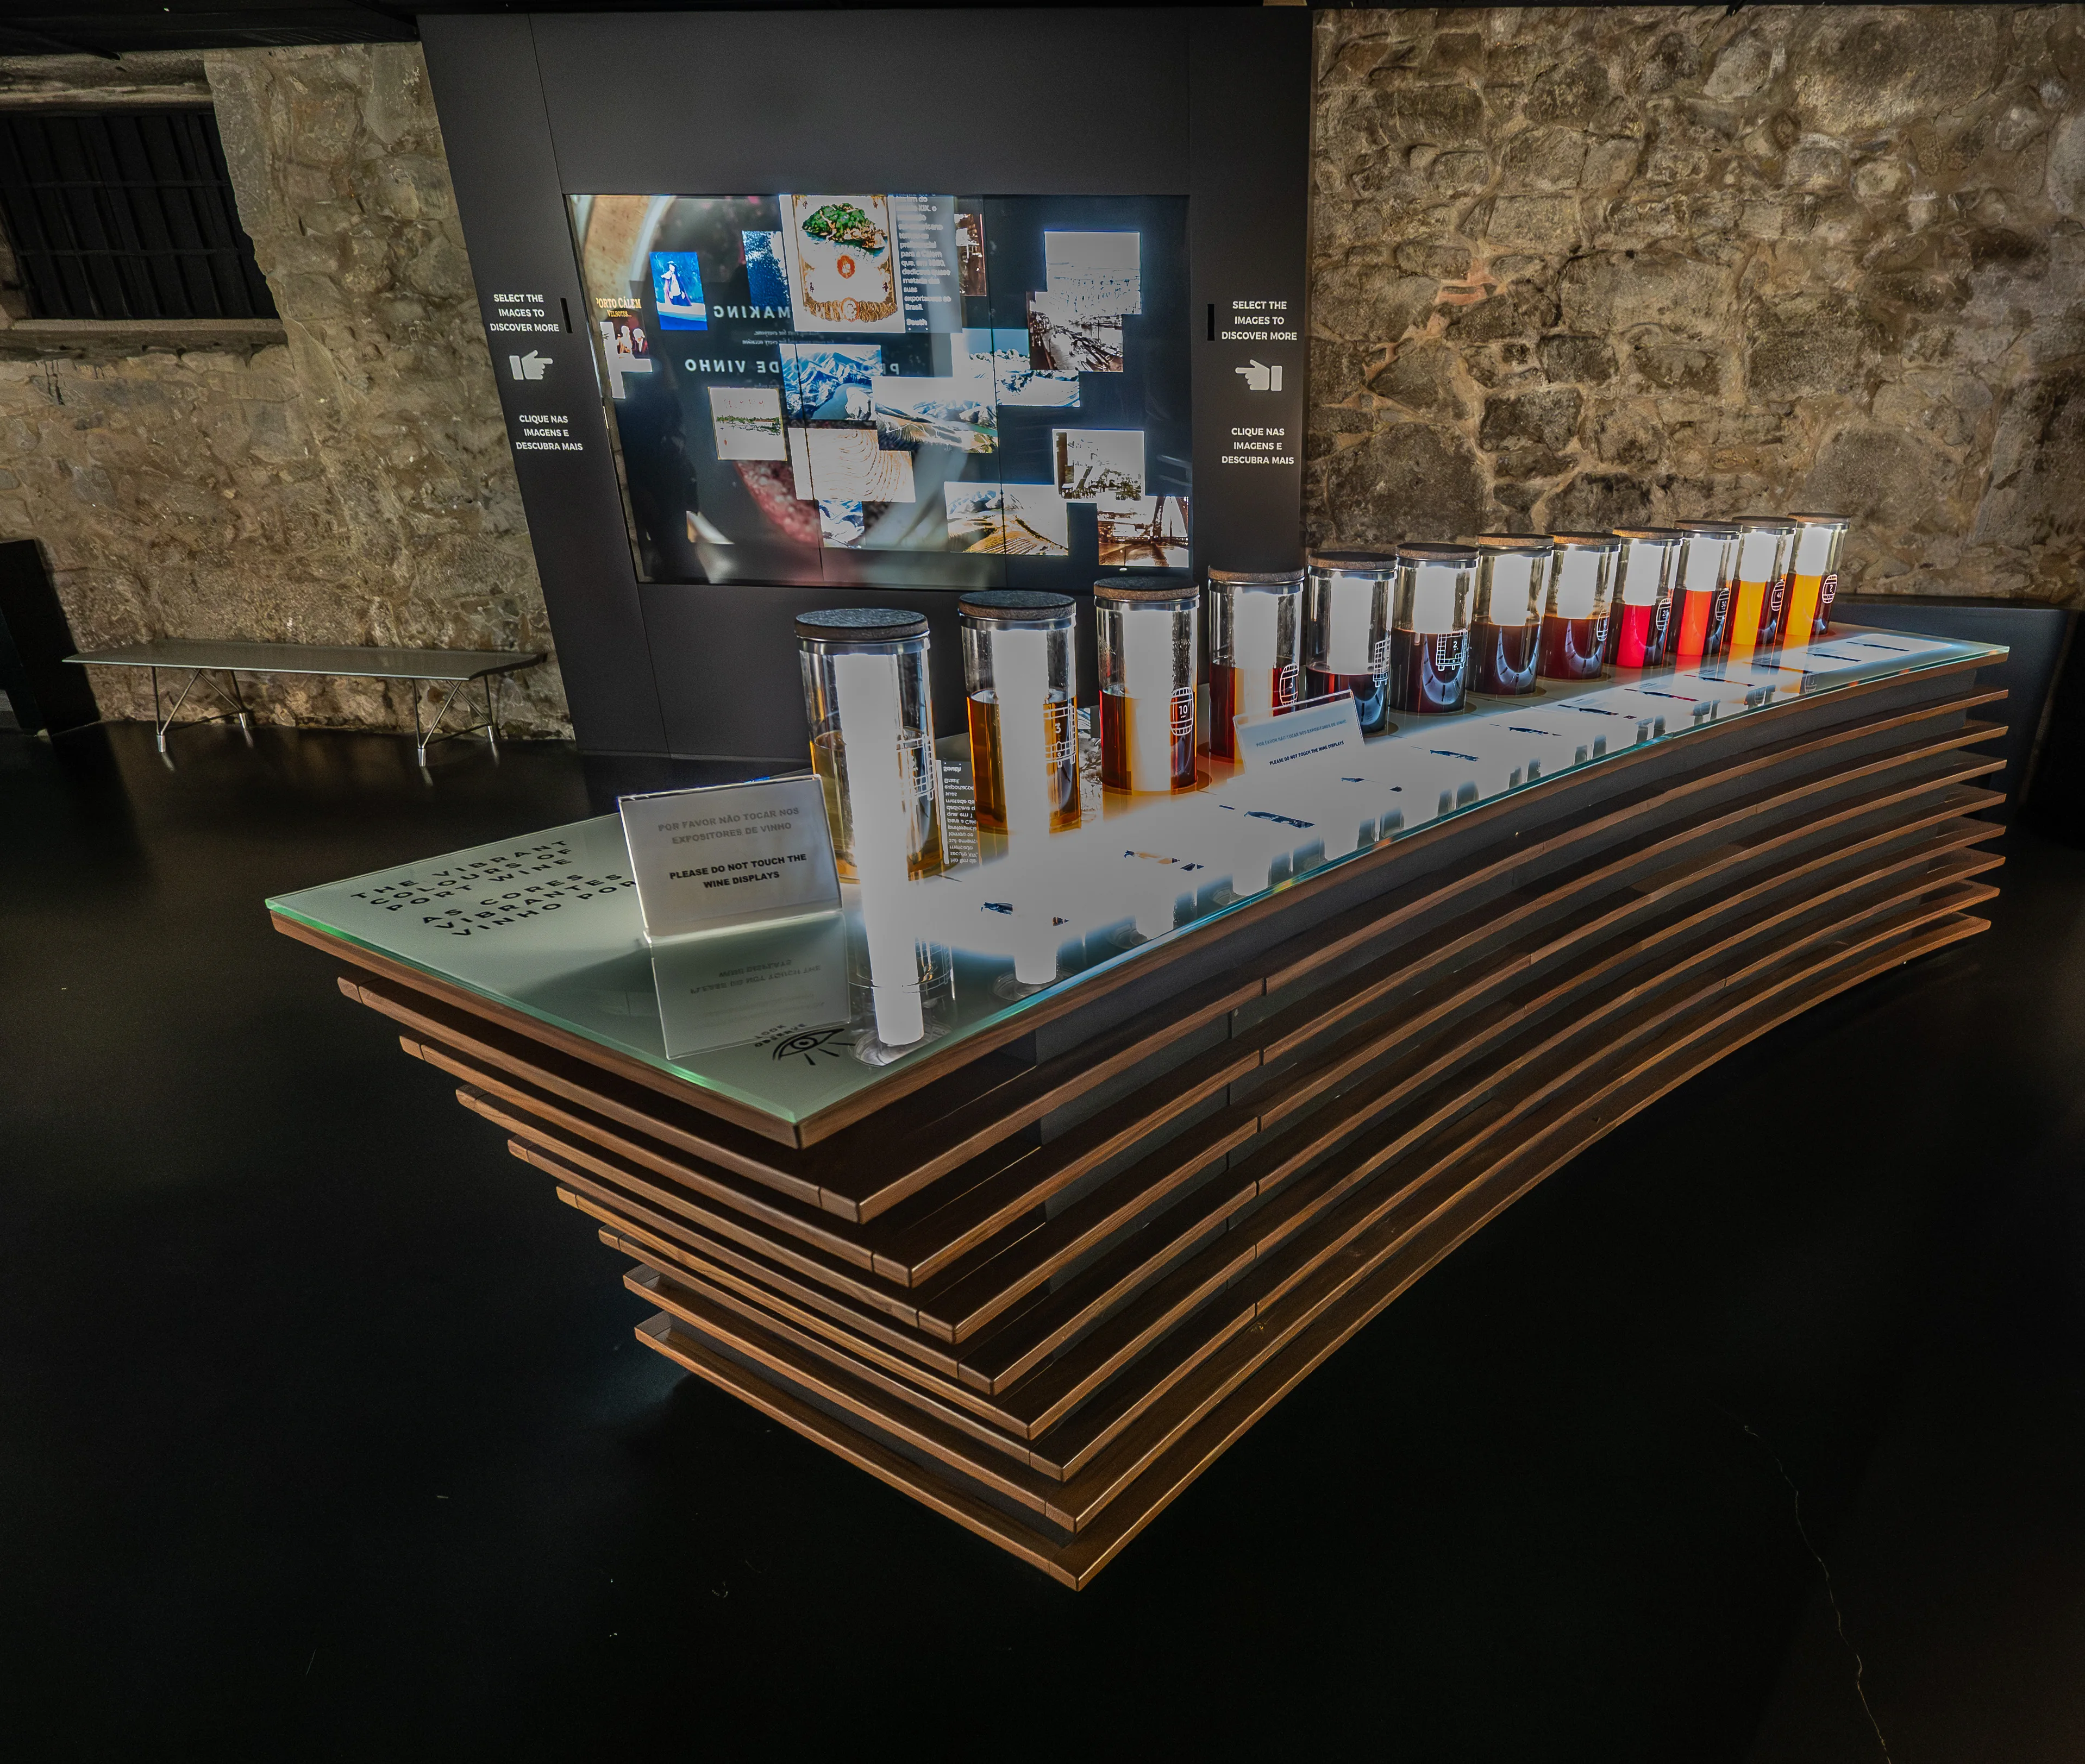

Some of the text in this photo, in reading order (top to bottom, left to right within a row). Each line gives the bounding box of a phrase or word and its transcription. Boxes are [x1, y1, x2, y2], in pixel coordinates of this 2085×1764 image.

[493, 294, 544, 303] SELECT THE
[1232, 301, 1287, 310] SELECT THE
[498, 309, 544, 317] IMAGES TO
[1235, 316, 1285, 325] IMAGES TO
[490, 323, 560, 332] DISCOVER MORE
[1222, 331, 1297, 341] DISCOVER MORE
[519, 415, 568, 424] CLIQUE NAS
[523, 428, 562, 436] IMAGENS
[1231, 428, 1264, 437] CLIQUE
[516, 442, 583, 450] DESCUBRA MAIS
[1234, 442, 1274, 450] IMAGENS
[1179, 705, 1188, 715] 10
[658, 807, 799, 832] POR FAVOR NÃO TOCAR NOS
[672, 822, 792, 844] EXPOSITORES DE VINHO
[350, 840, 567, 899] THE VIBRANT
[669, 853, 807, 879] PLEASE DO NOT TOUCH THE
[370, 849, 572, 905] COLOURS OF
[703, 871, 780, 888] WINE DISPLAYS
[386, 859, 572, 911] PORT WINE
[422, 875, 584, 924] AS CORES
[434, 874, 622, 929] VIBRANTES
[452, 881, 636, 936] VINHO POR
